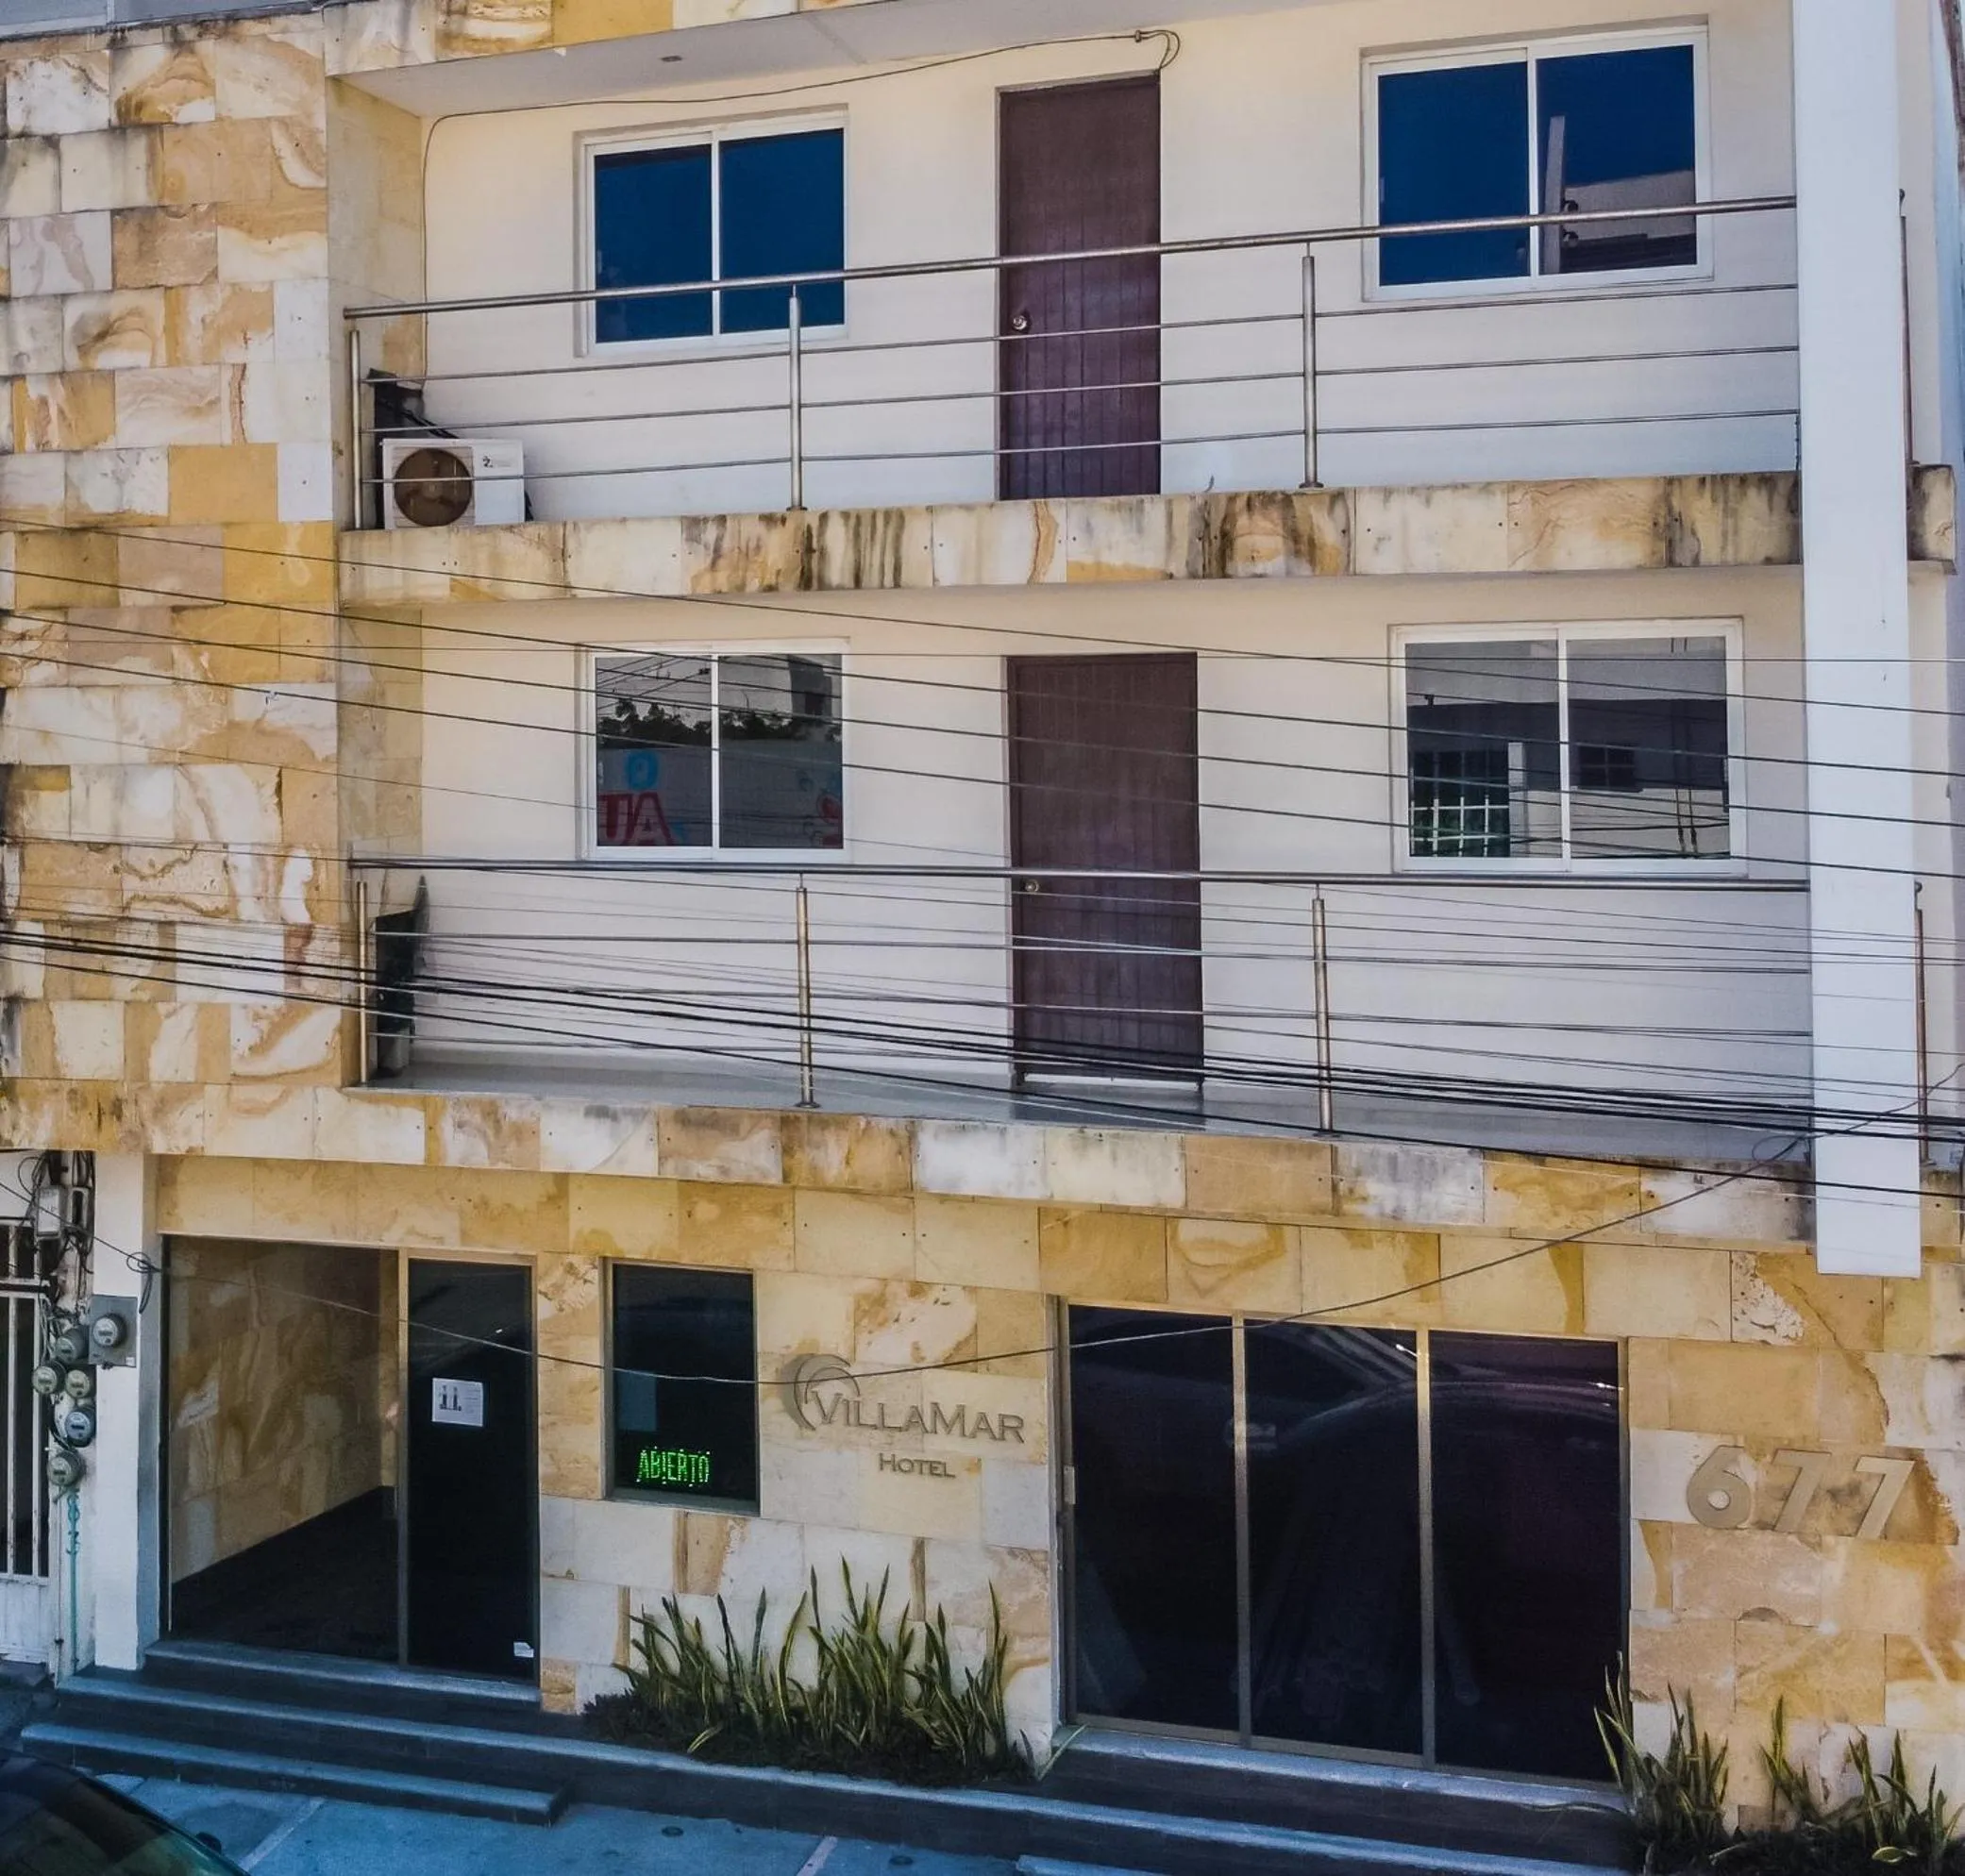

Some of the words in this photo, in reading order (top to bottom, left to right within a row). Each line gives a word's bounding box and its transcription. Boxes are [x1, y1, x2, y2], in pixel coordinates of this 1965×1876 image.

[810, 1390, 1025, 1444] VILLAMAR
[636, 1449, 710, 1483] ABIERTO
[879, 1452, 956, 1479] HOTEL
[1686, 1444, 1915, 1541] 677
